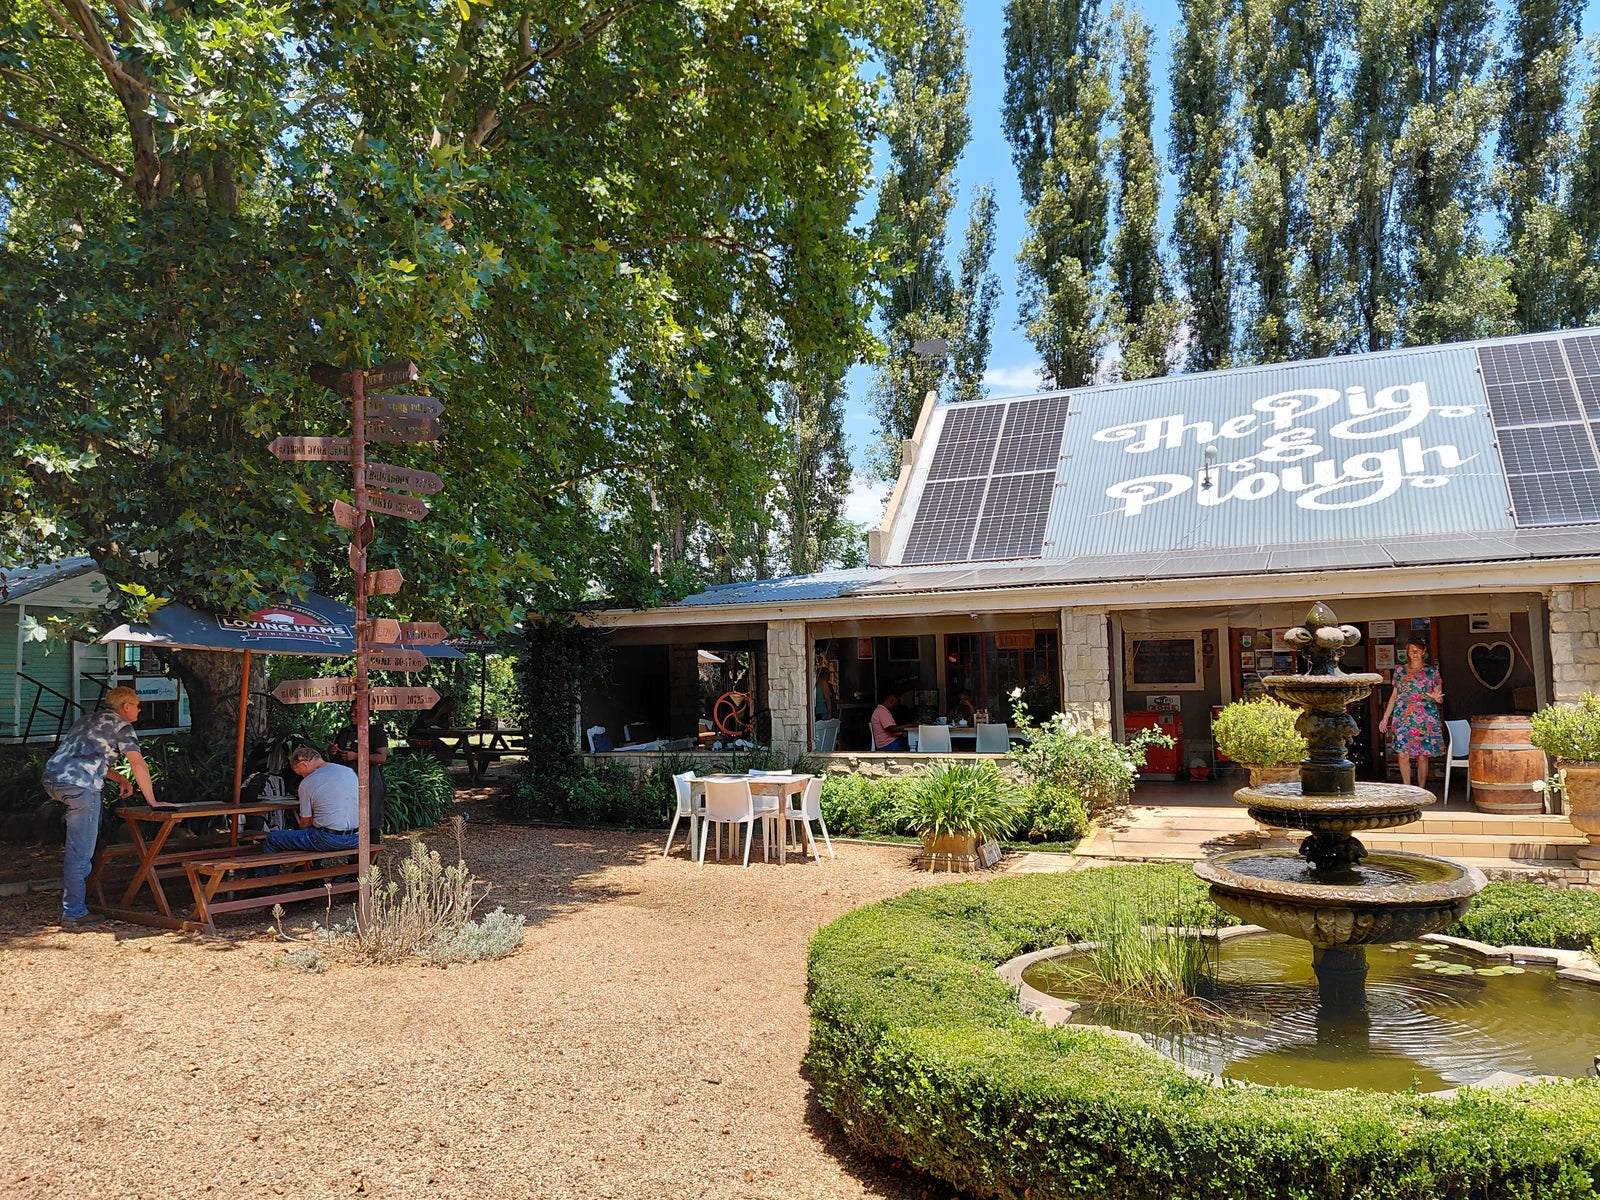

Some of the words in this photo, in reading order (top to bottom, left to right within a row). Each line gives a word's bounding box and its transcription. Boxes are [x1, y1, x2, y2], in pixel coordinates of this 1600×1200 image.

[1092, 414, 1259, 454] The
[1252, 381, 1475, 440] Pig
[1103, 437, 1481, 518] Plough
[367, 495, 393, 510] TOKYO
[291, 606, 330, 626] PRODUCTS
[221, 617, 292, 632] LOVING
[292, 623, 346, 637] HAMS
[371, 695, 399, 705] SYDNEY
